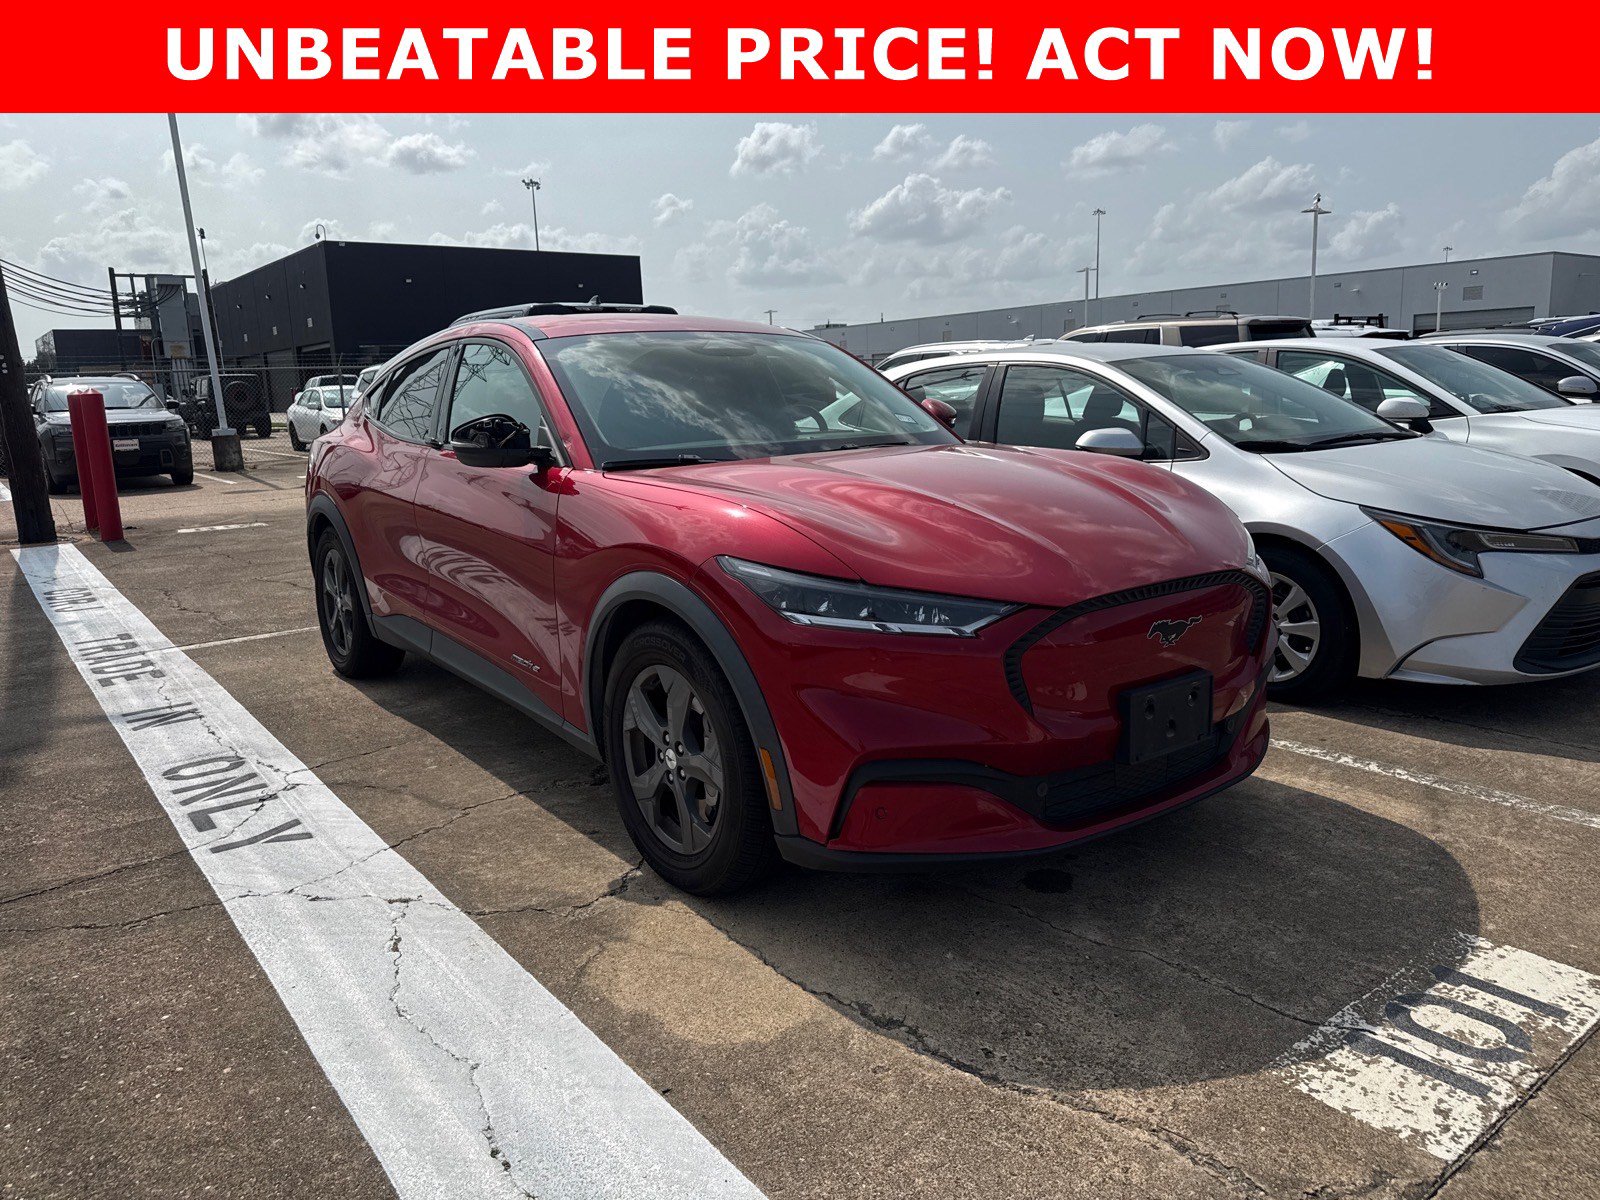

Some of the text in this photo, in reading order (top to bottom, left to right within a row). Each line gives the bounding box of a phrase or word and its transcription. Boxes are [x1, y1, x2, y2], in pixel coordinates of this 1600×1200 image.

[74, 633, 166, 687] TRADE
[121, 701, 204, 731] IN
[162, 755, 314, 854] ONLY
[1345, 964, 1571, 1098] 101
